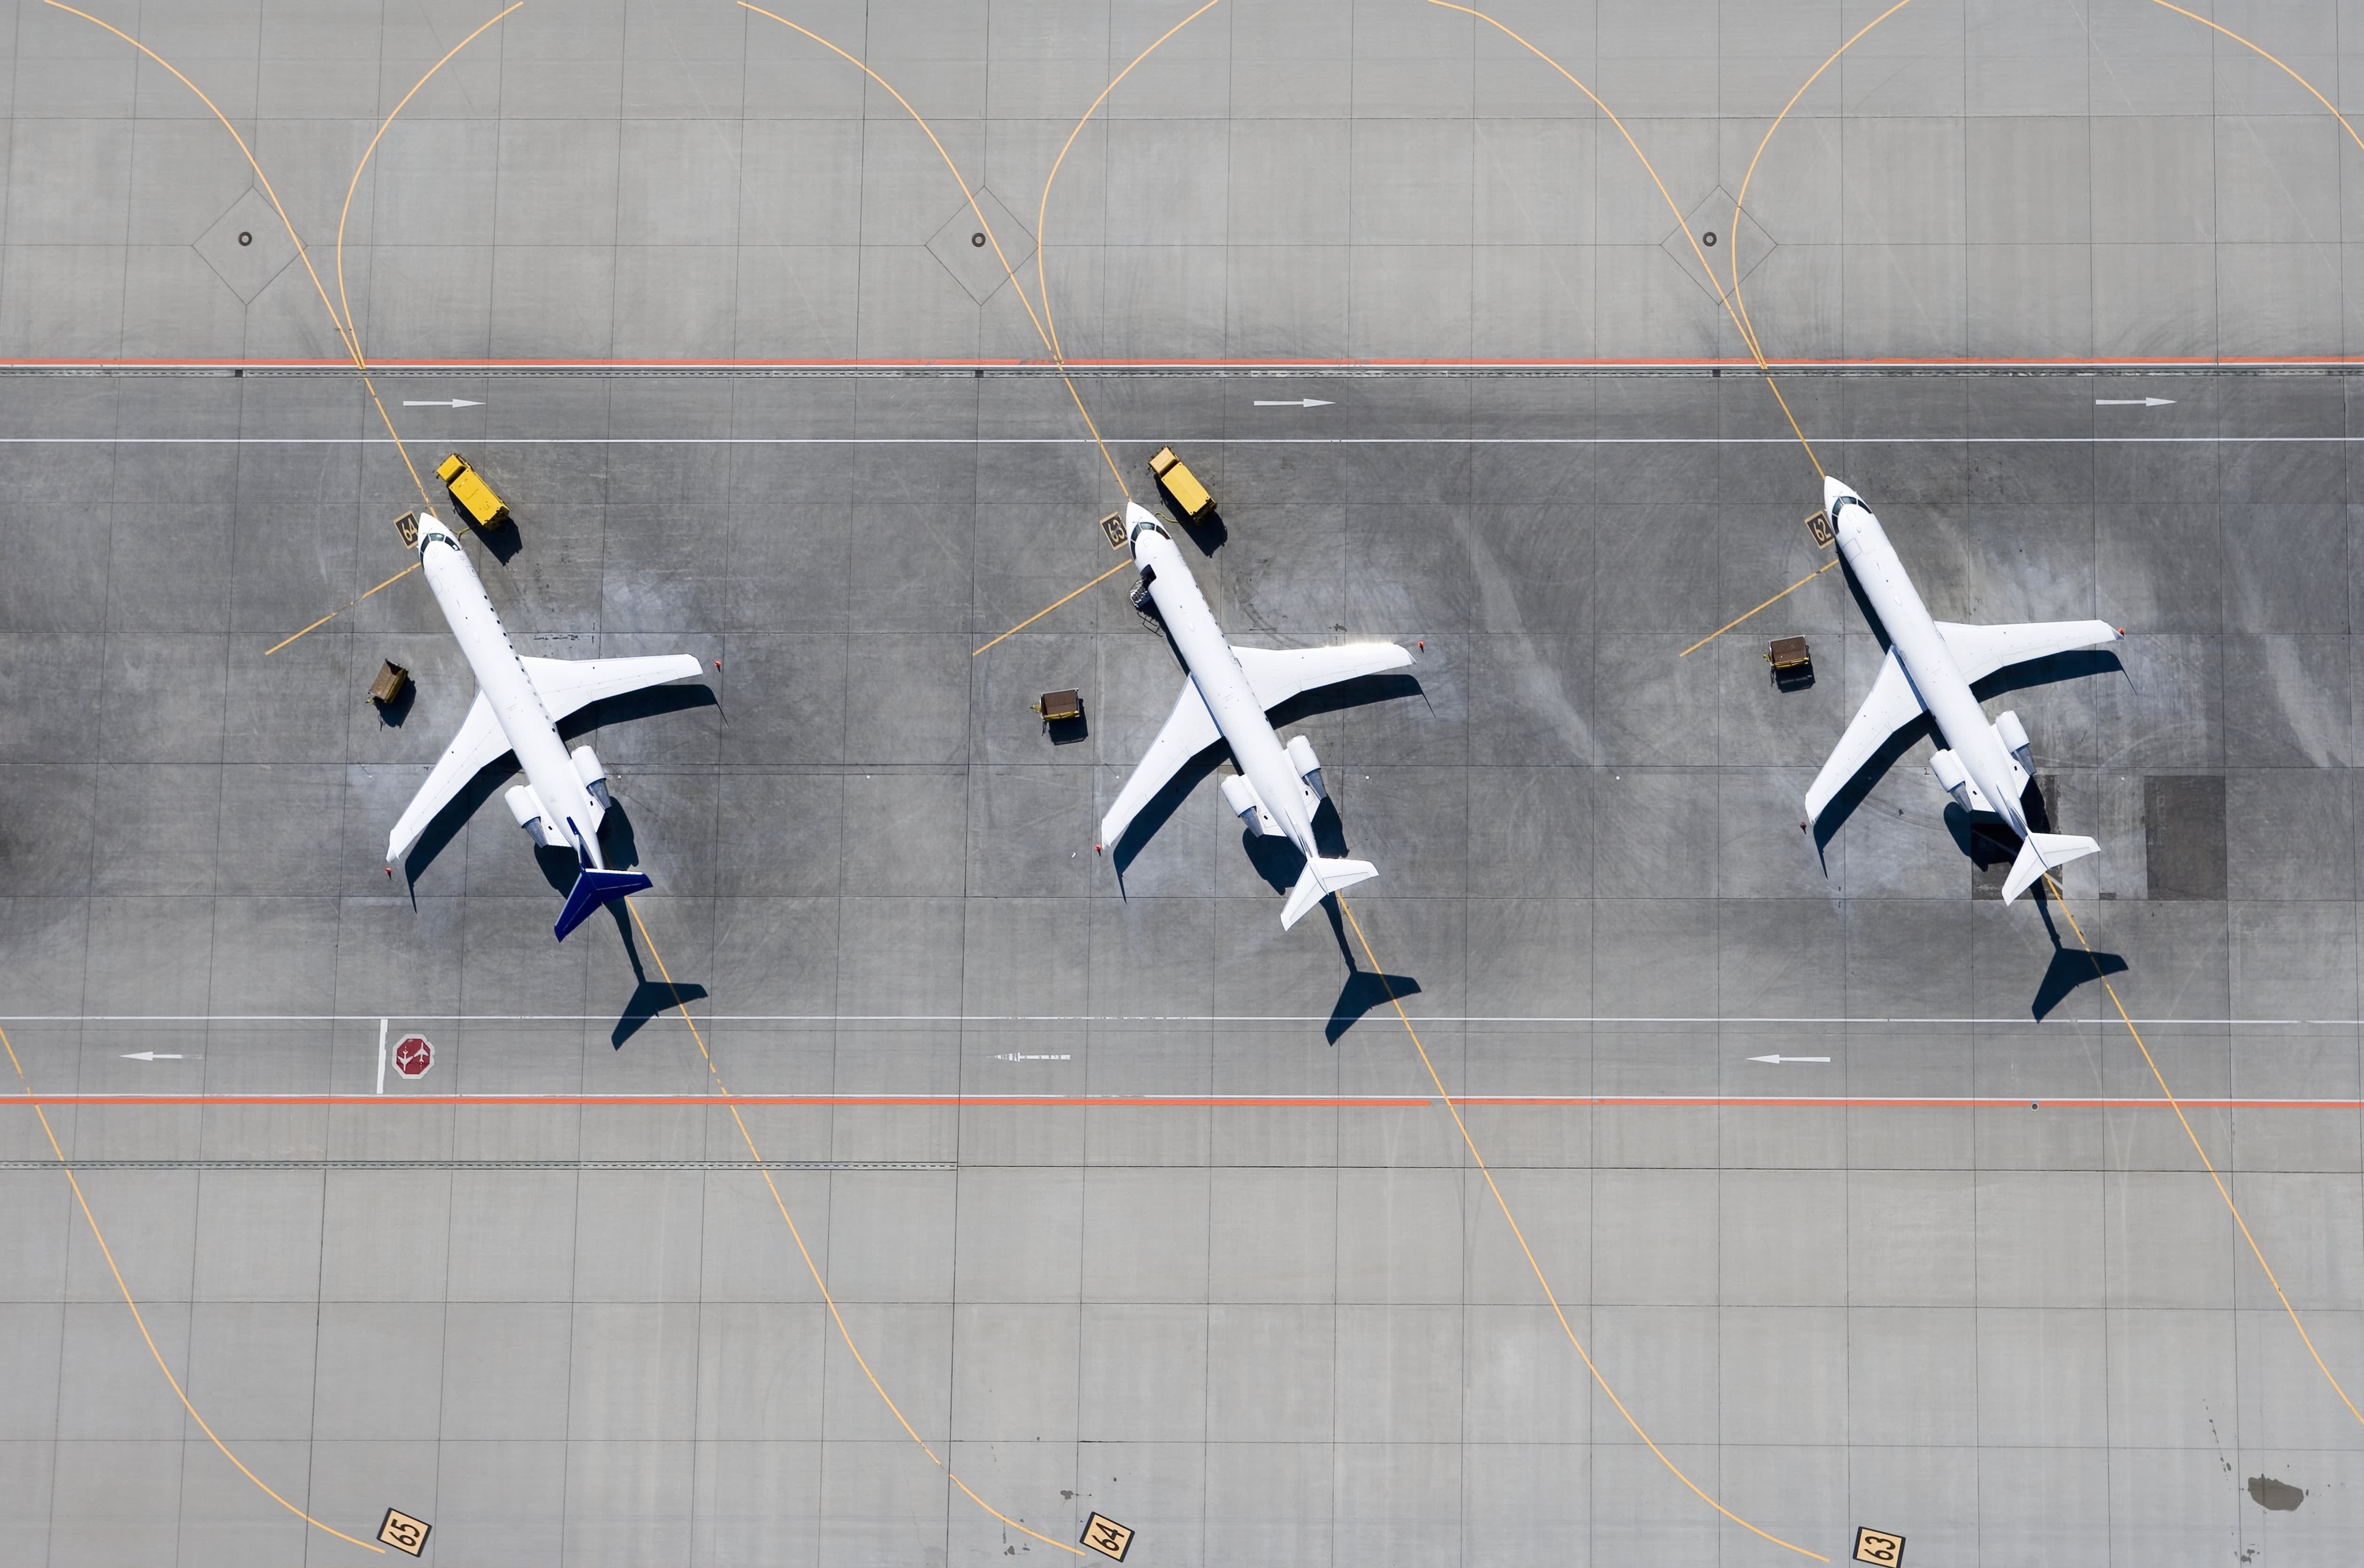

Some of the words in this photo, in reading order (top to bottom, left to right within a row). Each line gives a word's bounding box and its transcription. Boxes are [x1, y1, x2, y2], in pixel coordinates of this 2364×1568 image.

[1108, 519, 1125, 543] 63
[1813, 518, 1832, 542] 62
[388, 1519, 420, 1546] 65
[1091, 1522, 1124, 1551] 64
[1864, 1536, 1896, 1560] 63
